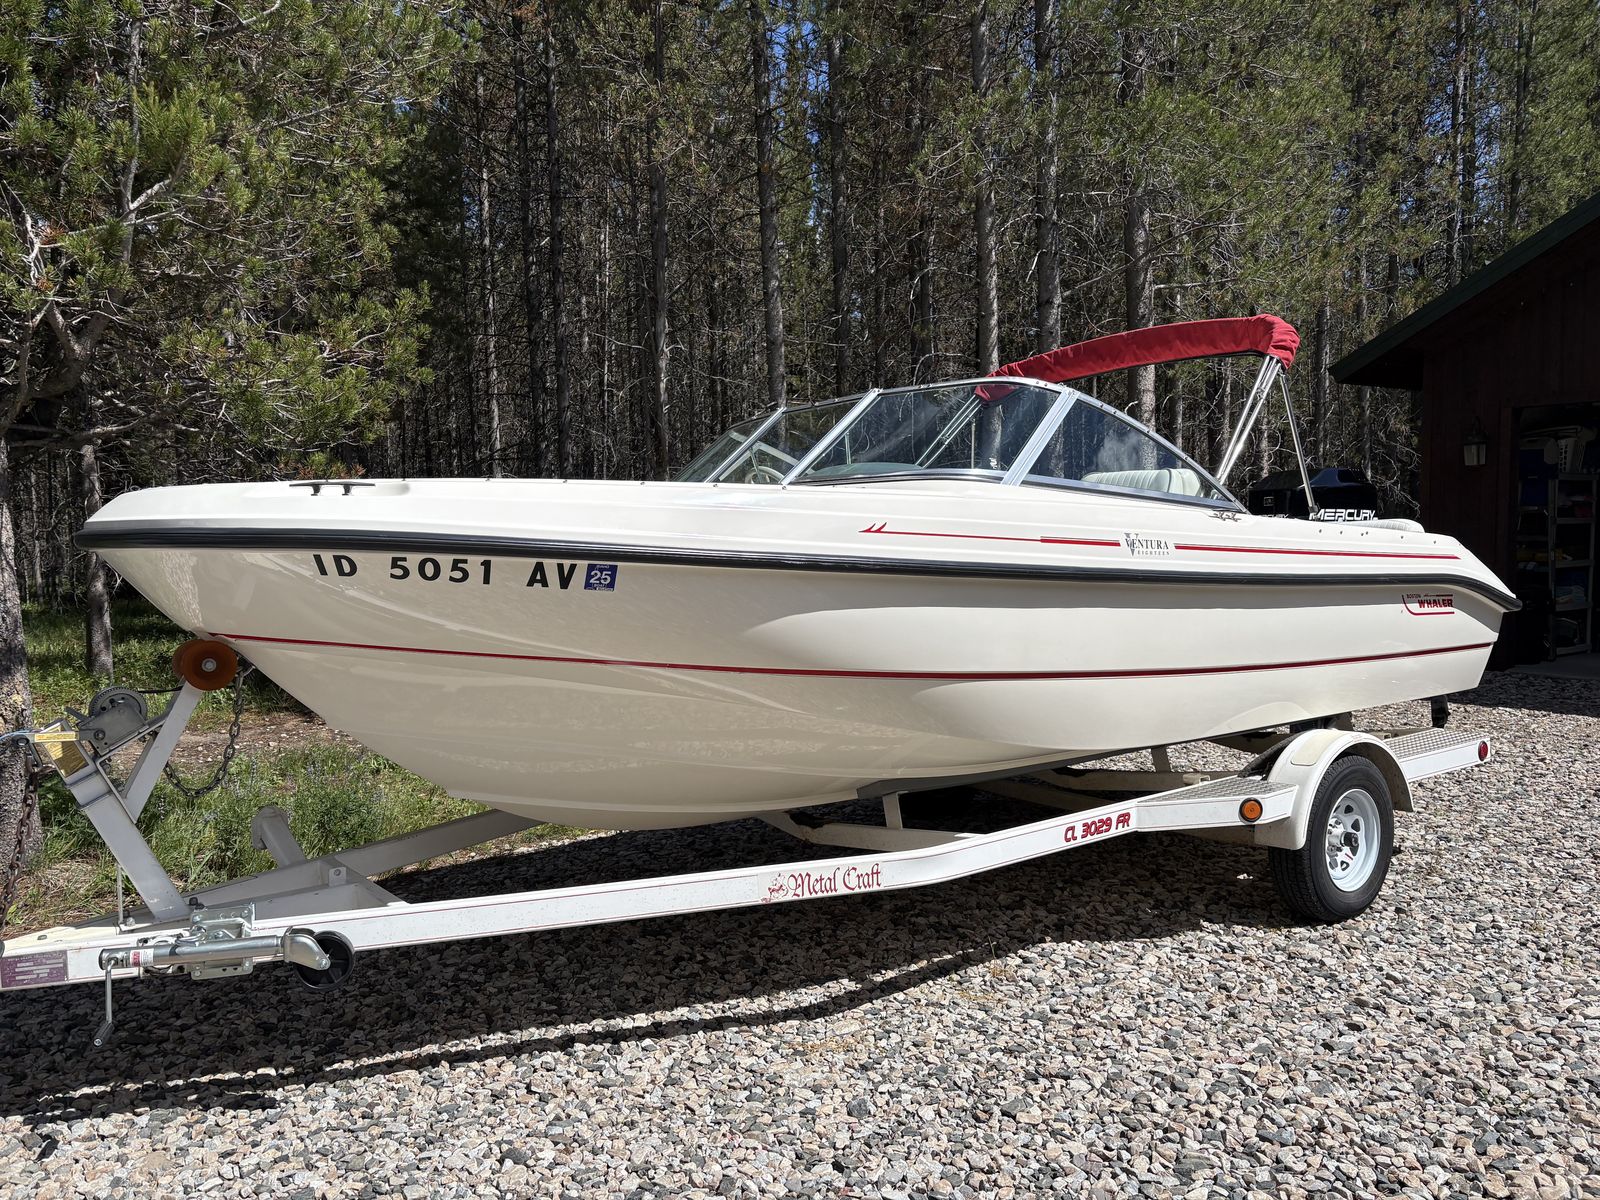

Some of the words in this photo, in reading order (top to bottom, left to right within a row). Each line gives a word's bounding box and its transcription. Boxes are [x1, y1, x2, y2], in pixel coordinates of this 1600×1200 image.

[1309, 508, 1375, 521] MERCURY
[1124, 533, 1169, 552] VENTURA
[312, 553, 358, 577] ID
[389, 556, 492, 585] 5051
[526, 561, 578, 590] AV
[589, 570, 612, 584] 25
[1417, 598, 1454, 609] WHALER
[1064, 825, 1078, 843] CL
[1081, 816, 1113, 839] 3029
[1115, 811, 1131, 830] FR
[787, 866, 841, 898] Metal
[843, 863, 882, 892] Craft
